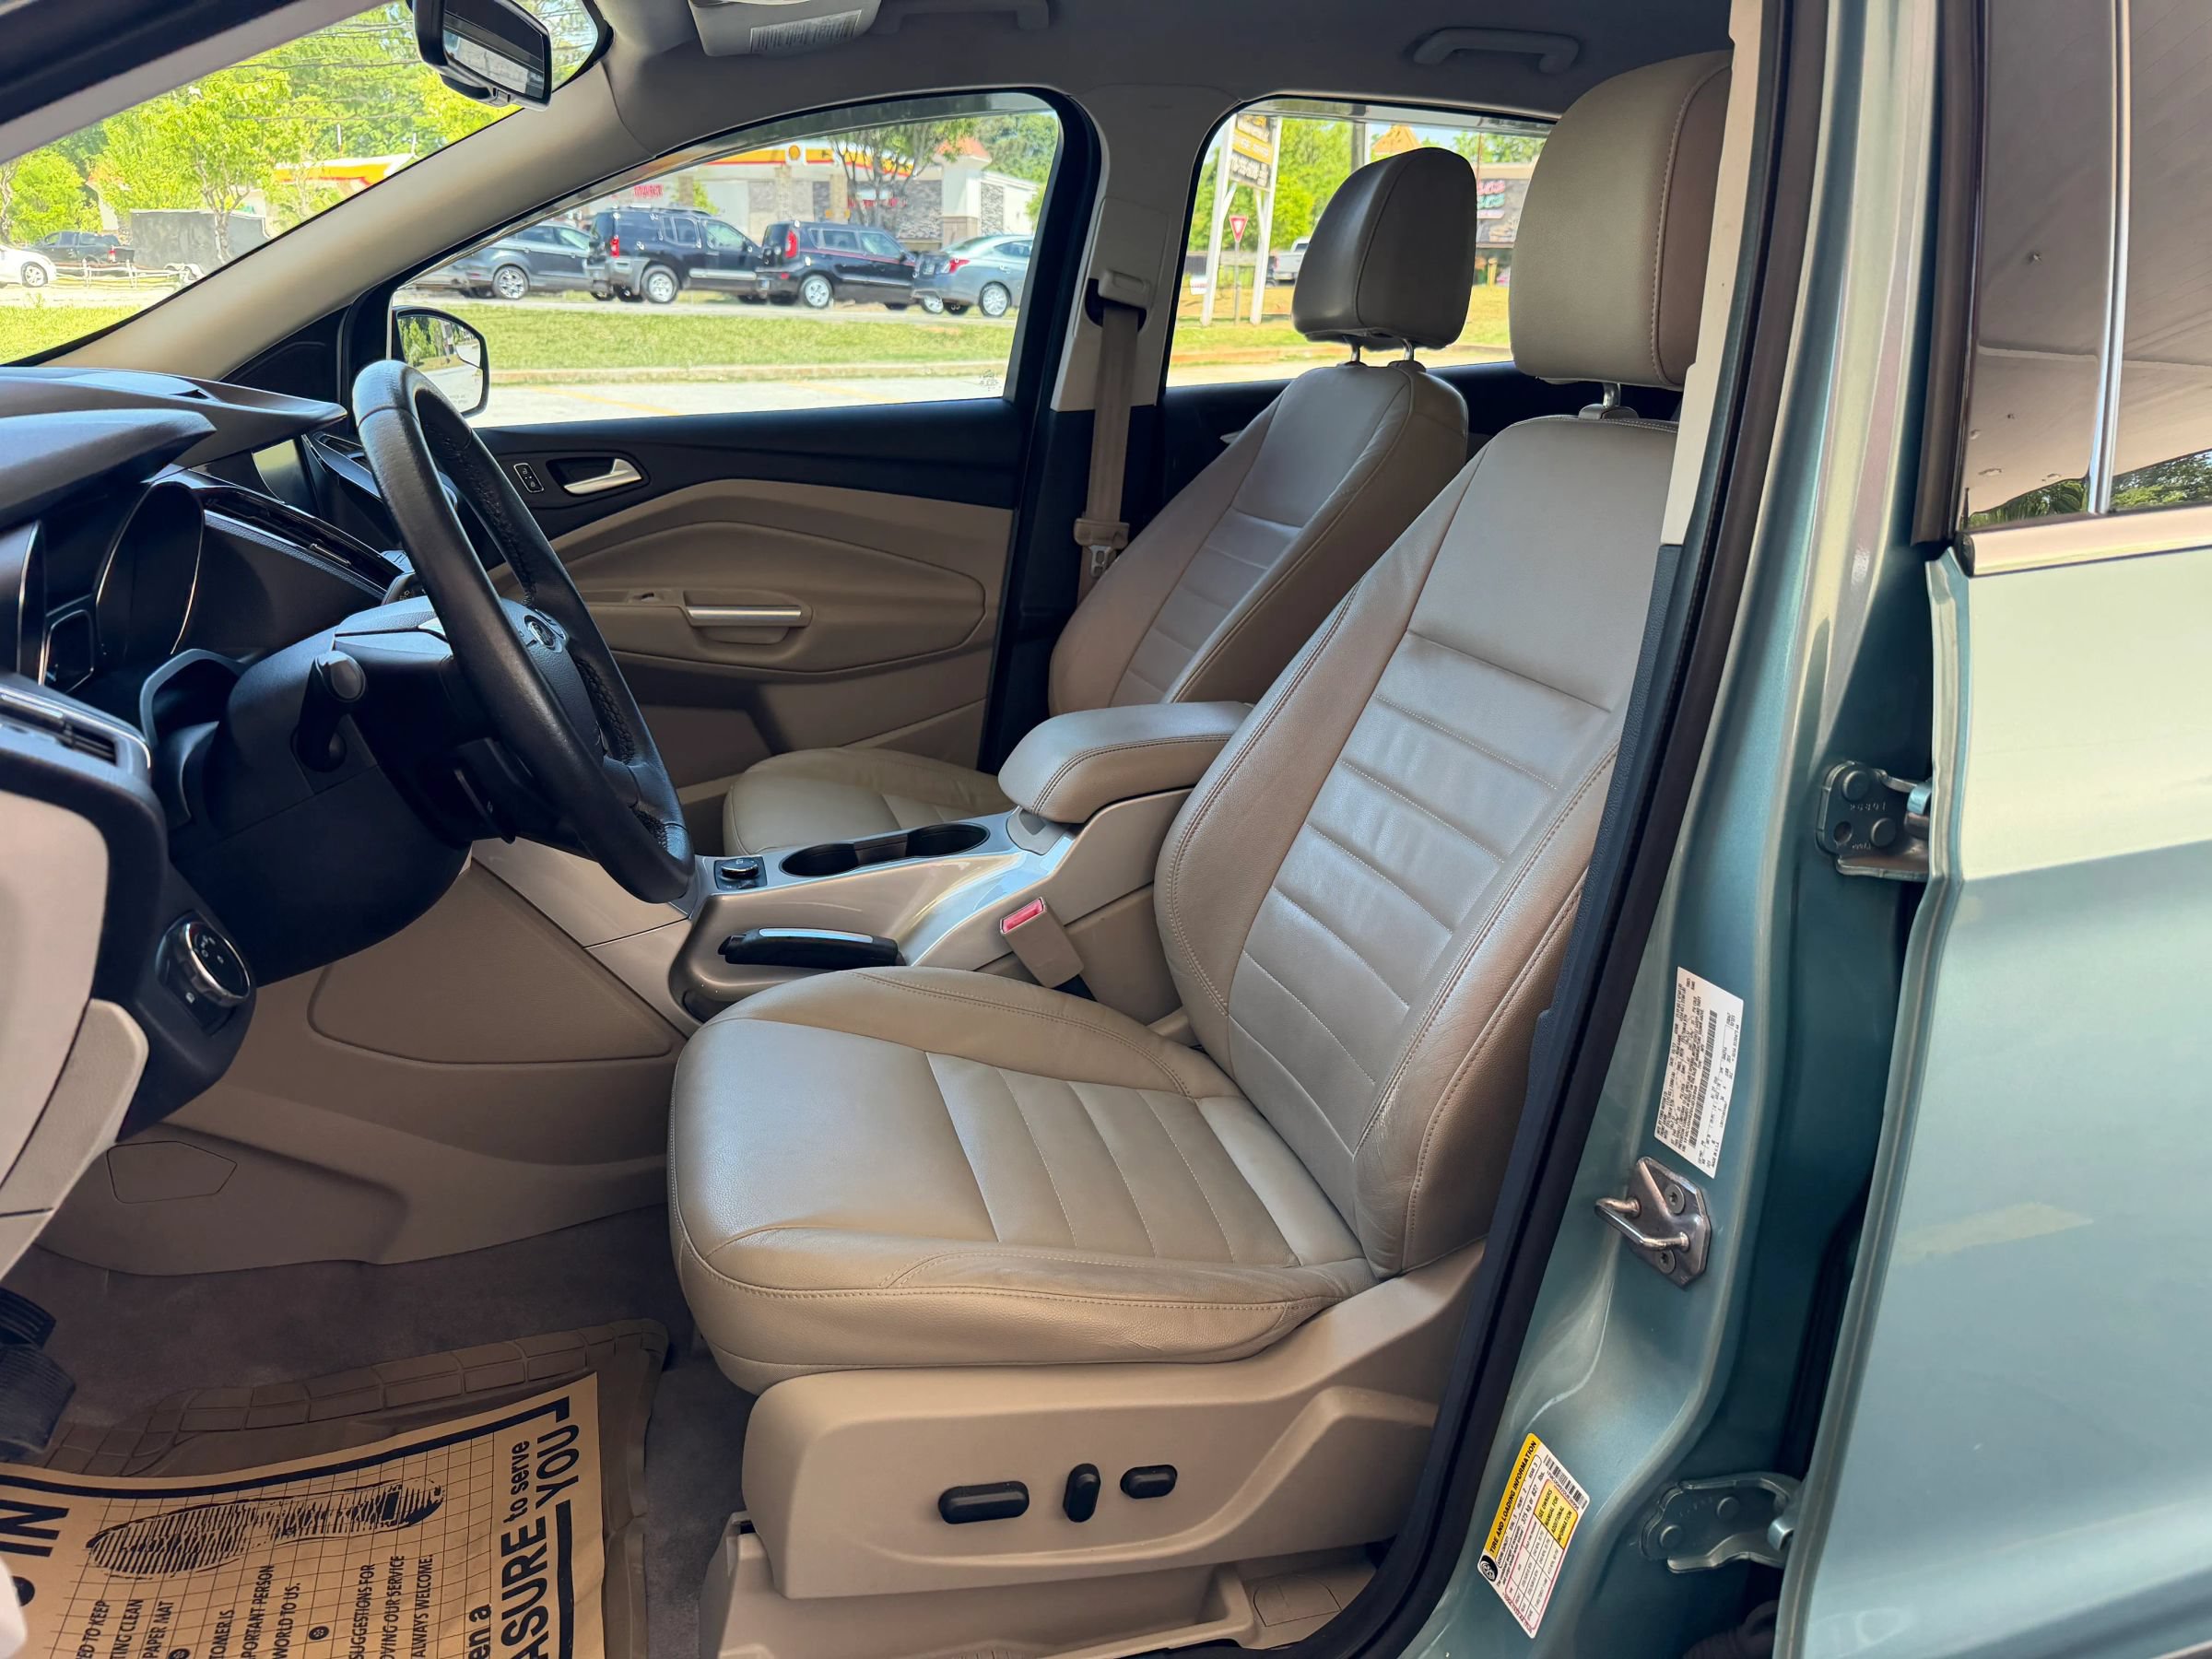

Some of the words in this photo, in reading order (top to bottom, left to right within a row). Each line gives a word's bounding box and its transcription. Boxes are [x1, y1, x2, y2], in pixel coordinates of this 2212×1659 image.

[511, 1440, 531, 1495] serve
[535, 1424, 580, 1510] YOU
[503, 1497, 529, 1524] to
[1489, 1538, 1500, 1553] TIRE
[1496, 1522, 1504, 1537] AND
[1501, 1489, 1513, 1523] LOADING
[1512, 1441, 1537, 1488] INFORMATION
[1545, 1507, 1555, 1526] MANUAL
[1551, 1506, 1564, 1534] ADDITIONAL
[1558, 1511, 1572, 1543] INFORMATION
[252, 1565, 275, 1605] PERSON
[359, 1563, 376, 1585] FOR
[386, 1555, 405, 1596] SERVICE
[416, 1554, 433, 1610] WELCOME.
[282, 1583, 301, 1600] US.
[88, 1600, 111, 1626] KEEP
[124, 1599, 144, 1632] CLEAN
[153, 1601, 175, 1625] MAT
[218, 1609, 235, 1619] IS
[279, 1602, 297, 1617] TO
[348, 1586, 372, 1659] SUGGESTIONS
[383, 1598, 401, 1623] OUR
[469, 1604, 492, 1622] a
[82, 1628, 100, 1641] TO
[142, 1626, 168, 1659] PAPER
[272, 1618, 294, 1659] WORLD
[411, 1612, 429, 1658] ALWAYS
